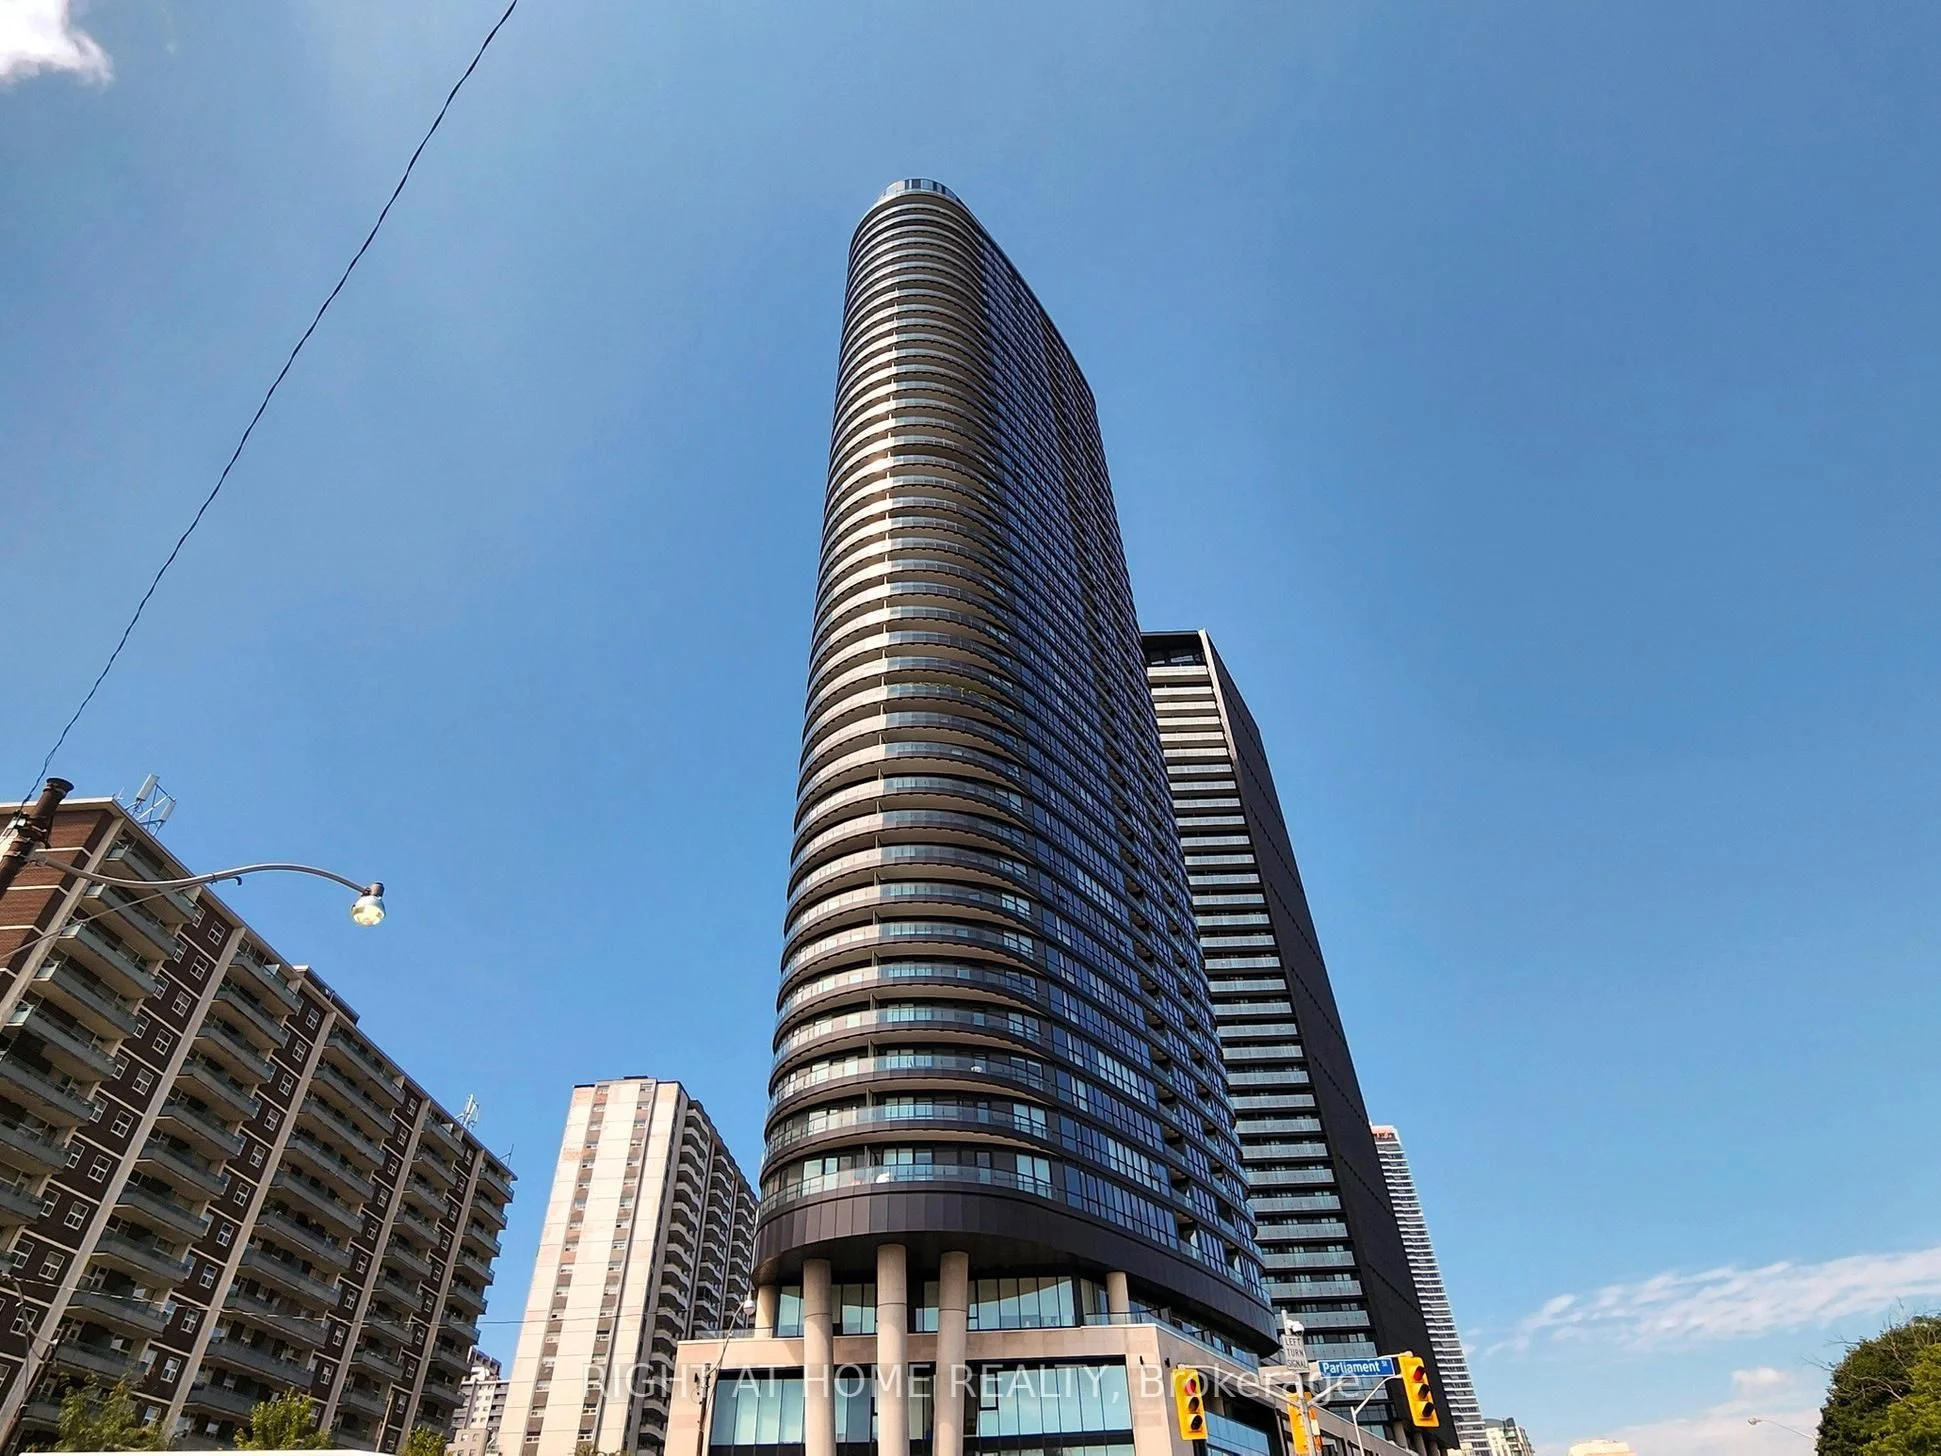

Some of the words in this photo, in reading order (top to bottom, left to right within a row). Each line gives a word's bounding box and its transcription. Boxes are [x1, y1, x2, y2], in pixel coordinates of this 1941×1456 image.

[1285, 1337, 1302, 1346] LEFT
[1287, 1348, 1305, 1357] TURN
[1287, 1360, 1308, 1369] SIGNAL
[1322, 1361, 1381, 1374] Parliament
